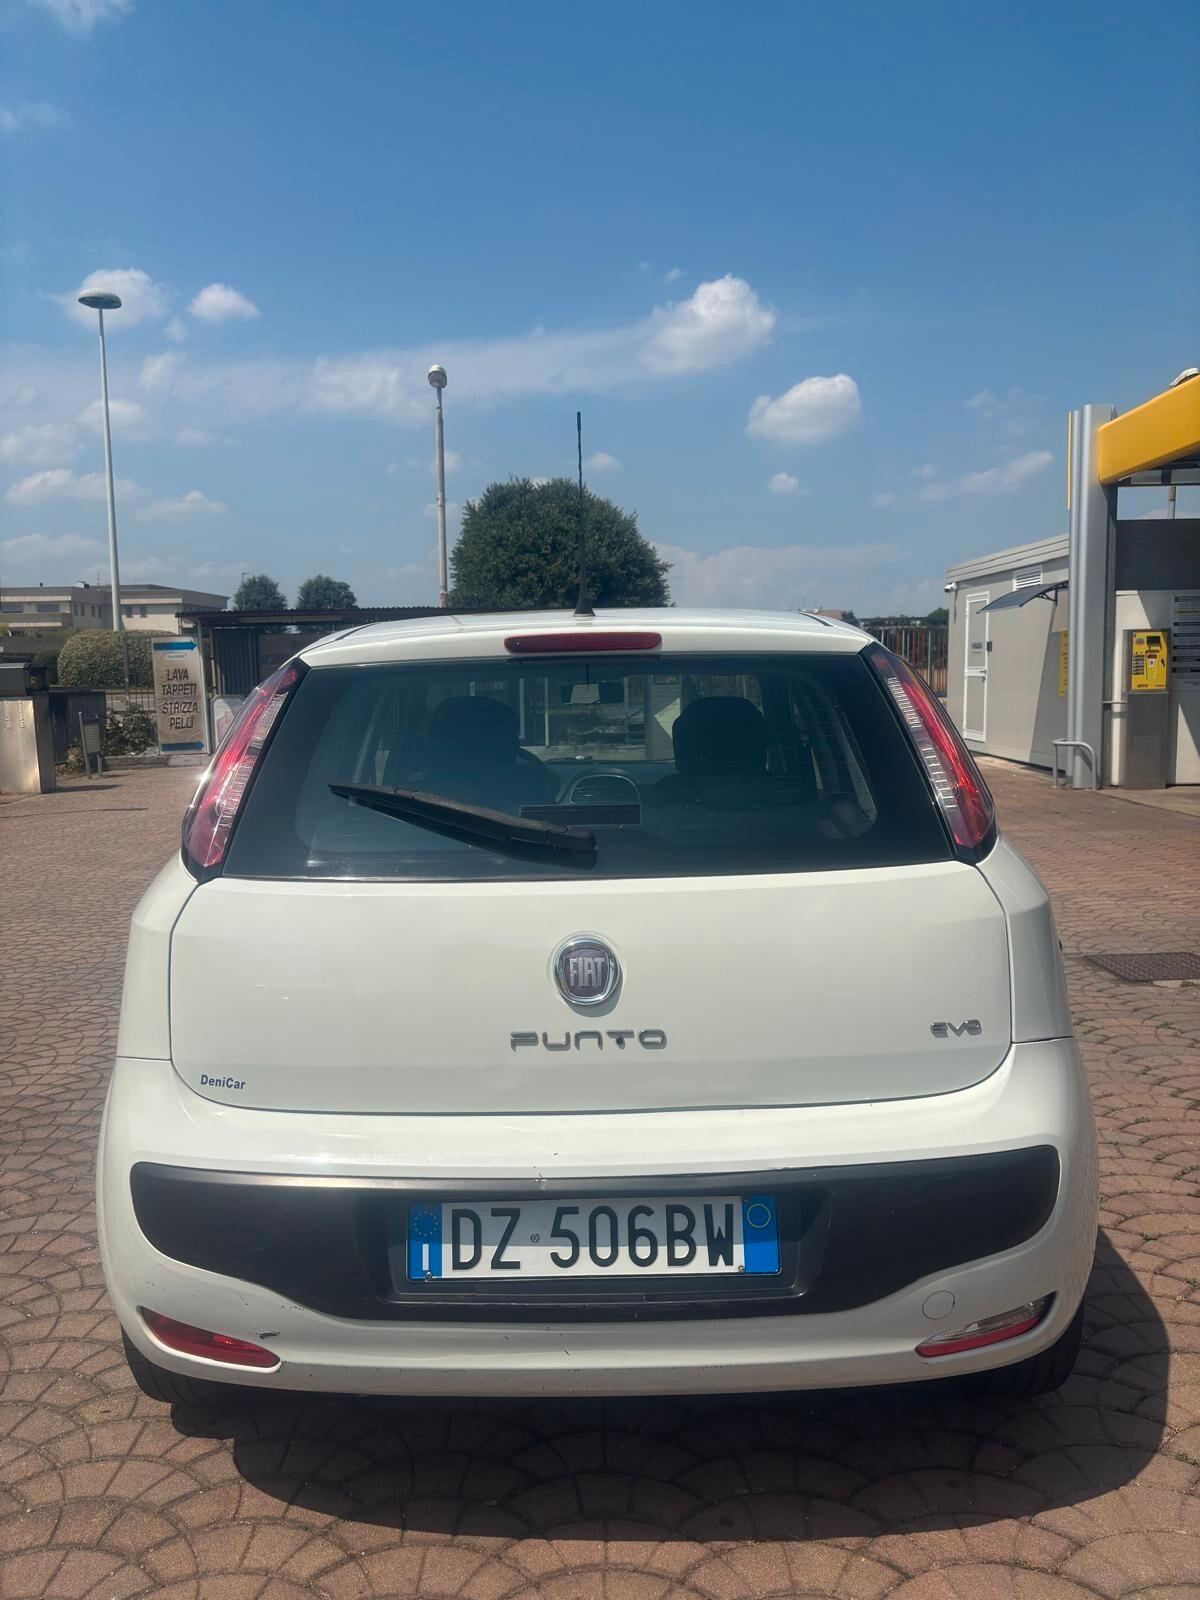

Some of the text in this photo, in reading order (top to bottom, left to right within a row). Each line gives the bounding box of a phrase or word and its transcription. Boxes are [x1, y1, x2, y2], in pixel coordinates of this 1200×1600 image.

[167, 668, 189, 680] LAVA
[162, 683, 197, 695] TAPPETI
[162, 701, 198, 714] STRIZZA
[169, 717, 194, 730] PELLI
[569, 957, 605, 987] FIAT
[510, 1029, 667, 1052] PUNTO
[200, 1074, 246, 1090] DeniCar
[452, 1204, 734, 1271] DZ 506BW
